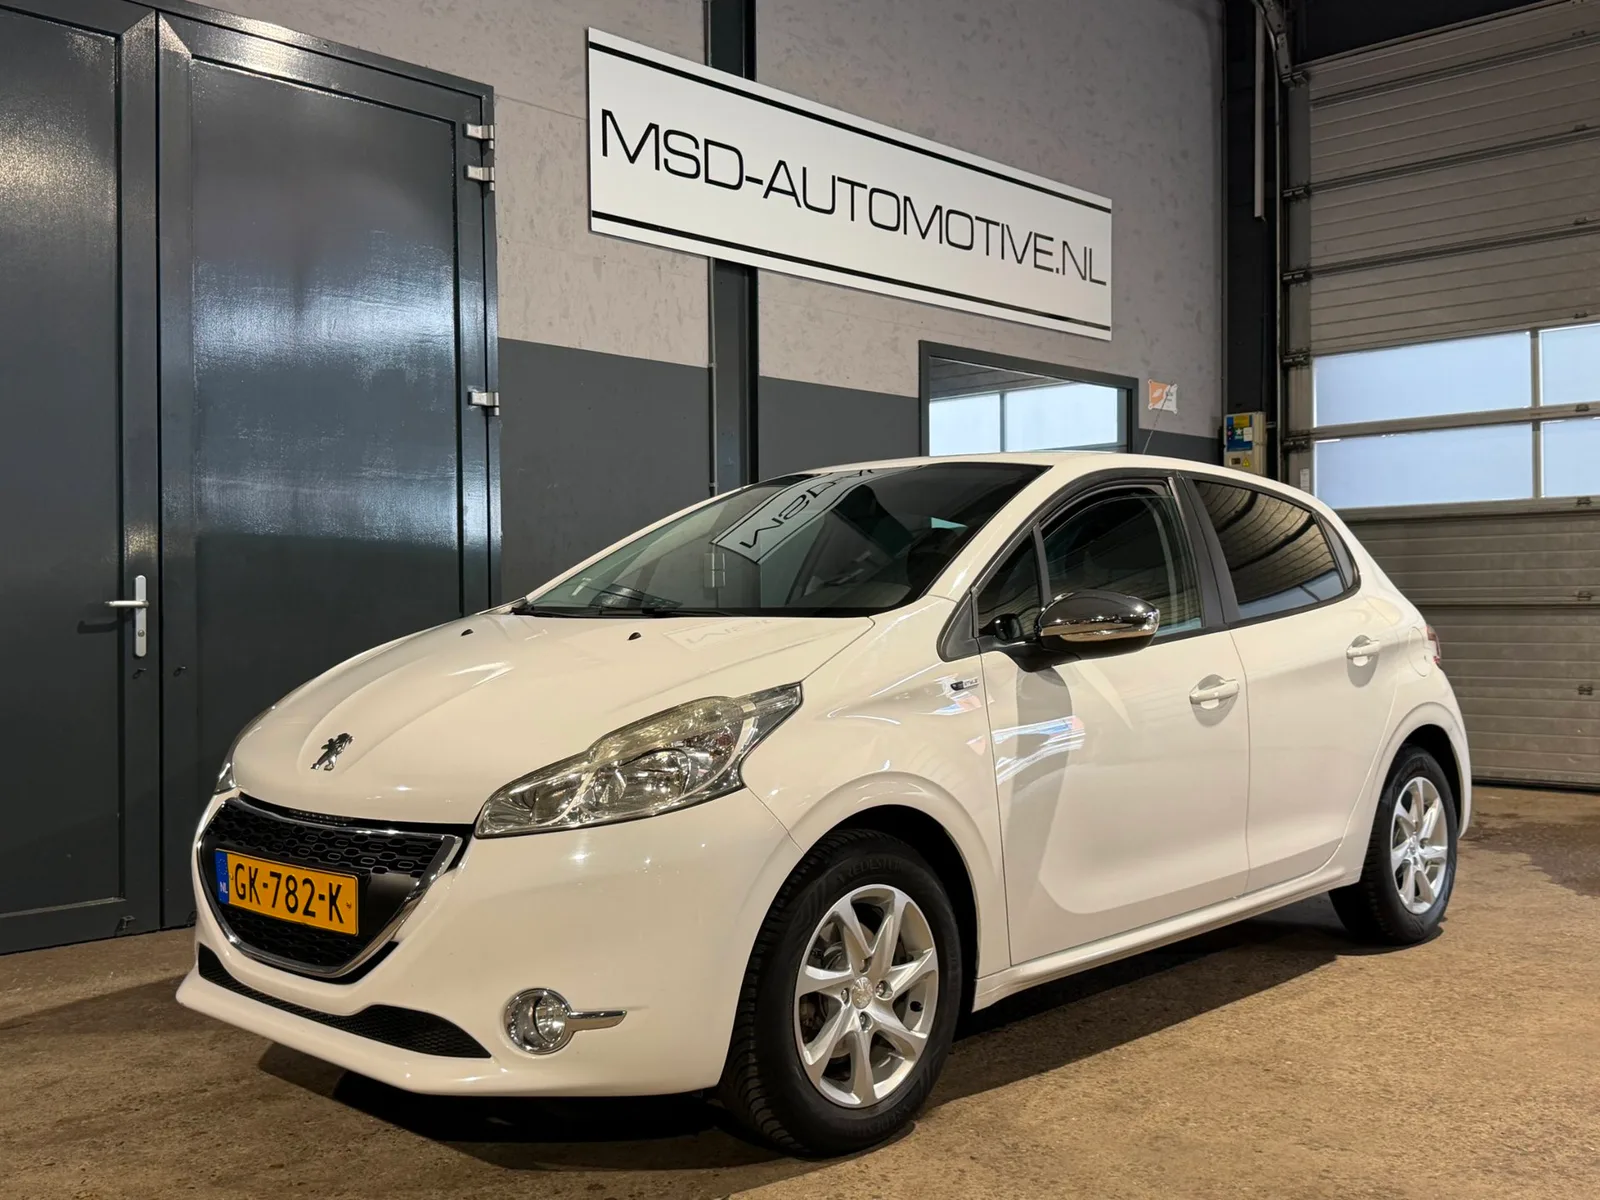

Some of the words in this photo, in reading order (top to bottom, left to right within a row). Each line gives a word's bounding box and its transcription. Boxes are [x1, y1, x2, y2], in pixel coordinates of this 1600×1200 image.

[601, 108, 1108, 286] MSD-AUTOMOTIVE.NL
[219, 881, 229, 894] NL
[234, 863, 344, 924] GK-782-K
